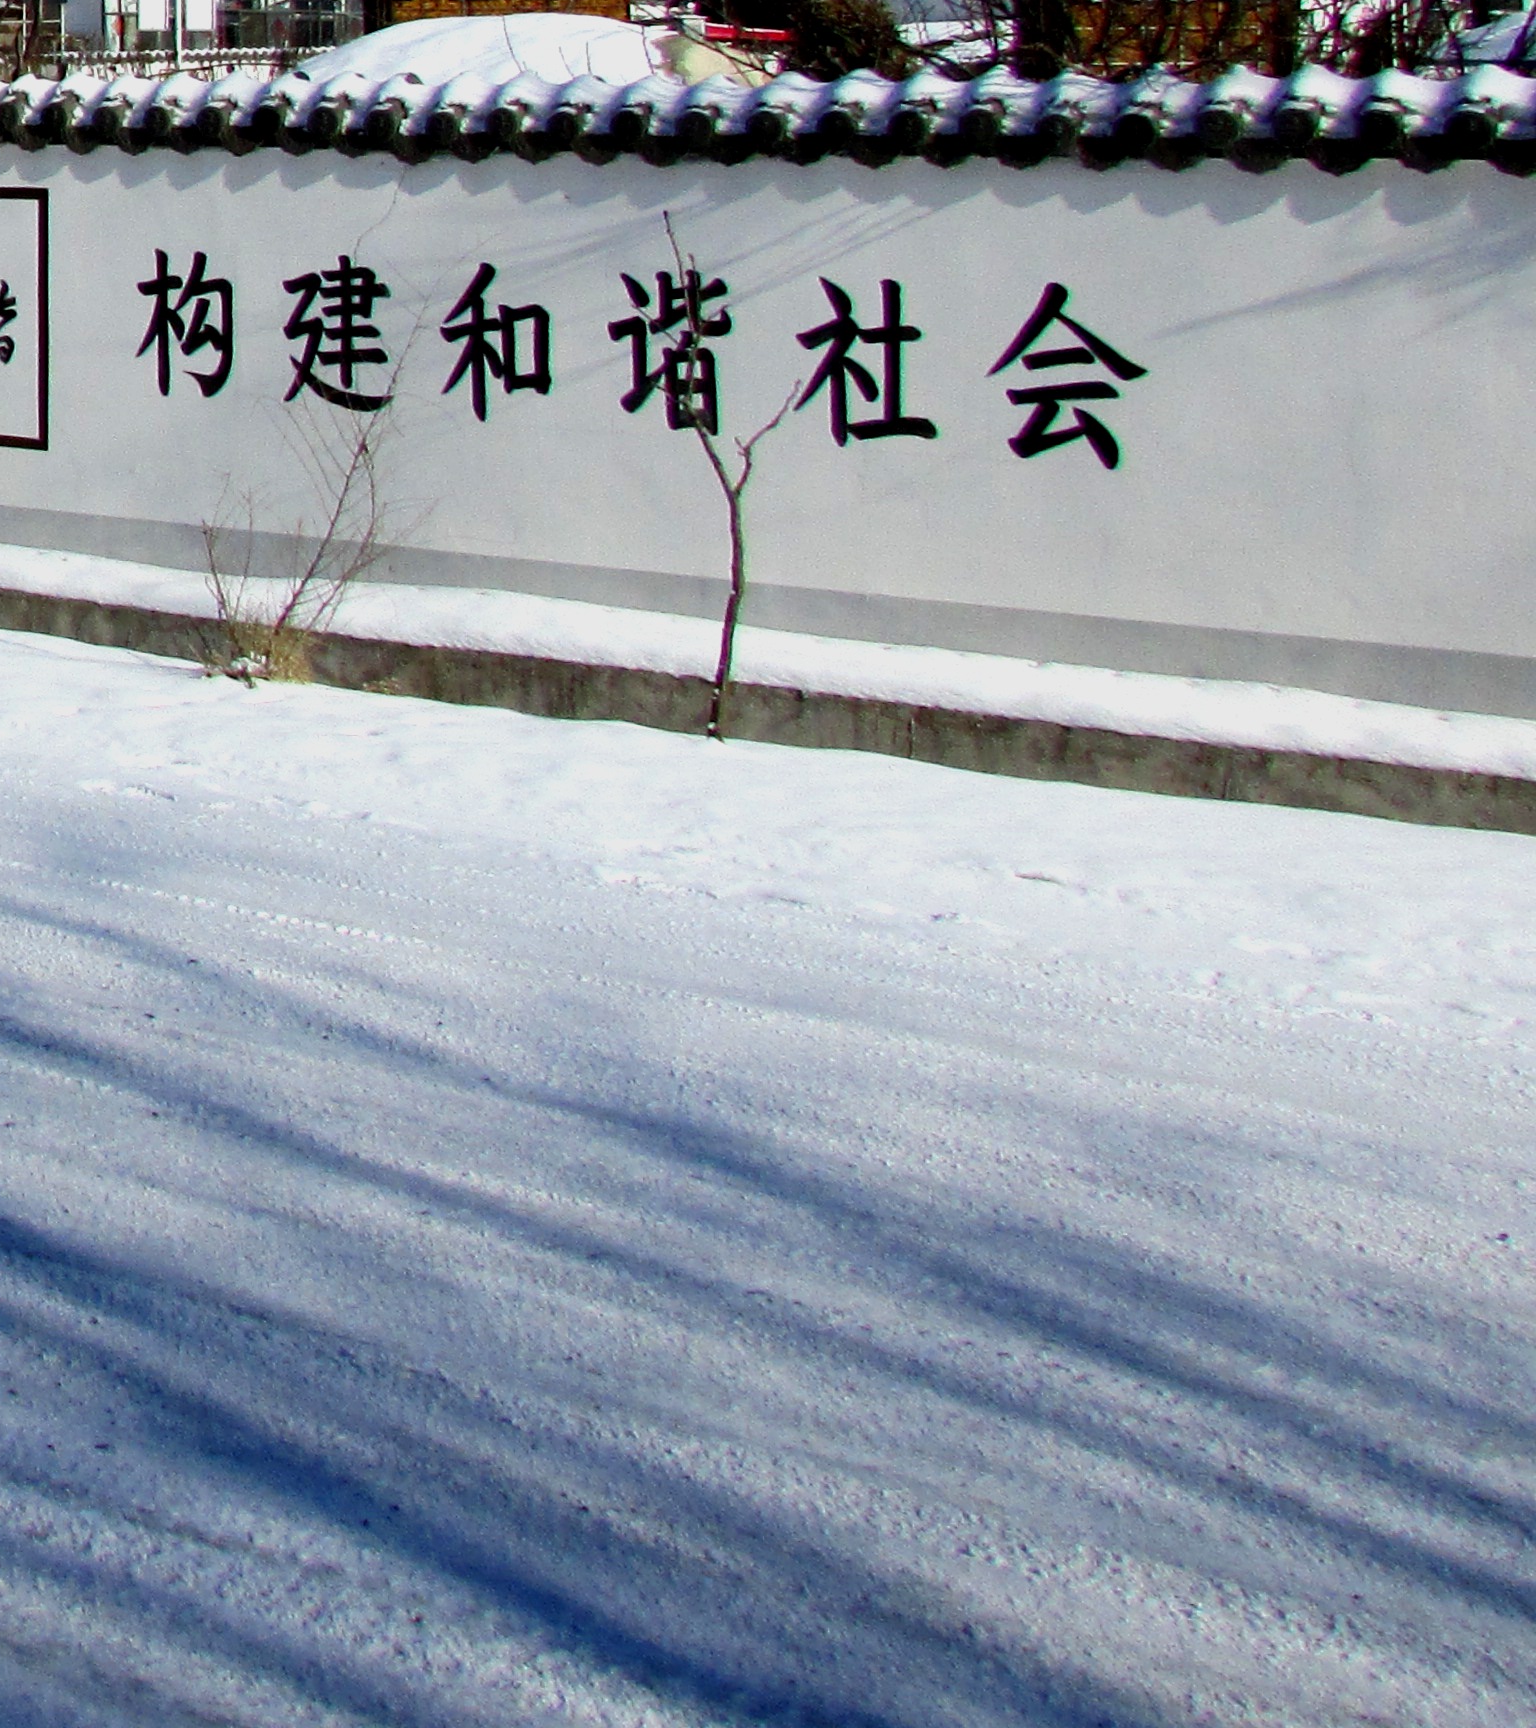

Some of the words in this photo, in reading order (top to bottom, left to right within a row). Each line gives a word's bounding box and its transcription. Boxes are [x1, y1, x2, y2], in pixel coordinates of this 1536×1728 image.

[136, 248, 1148, 471] 构建和谐社会
